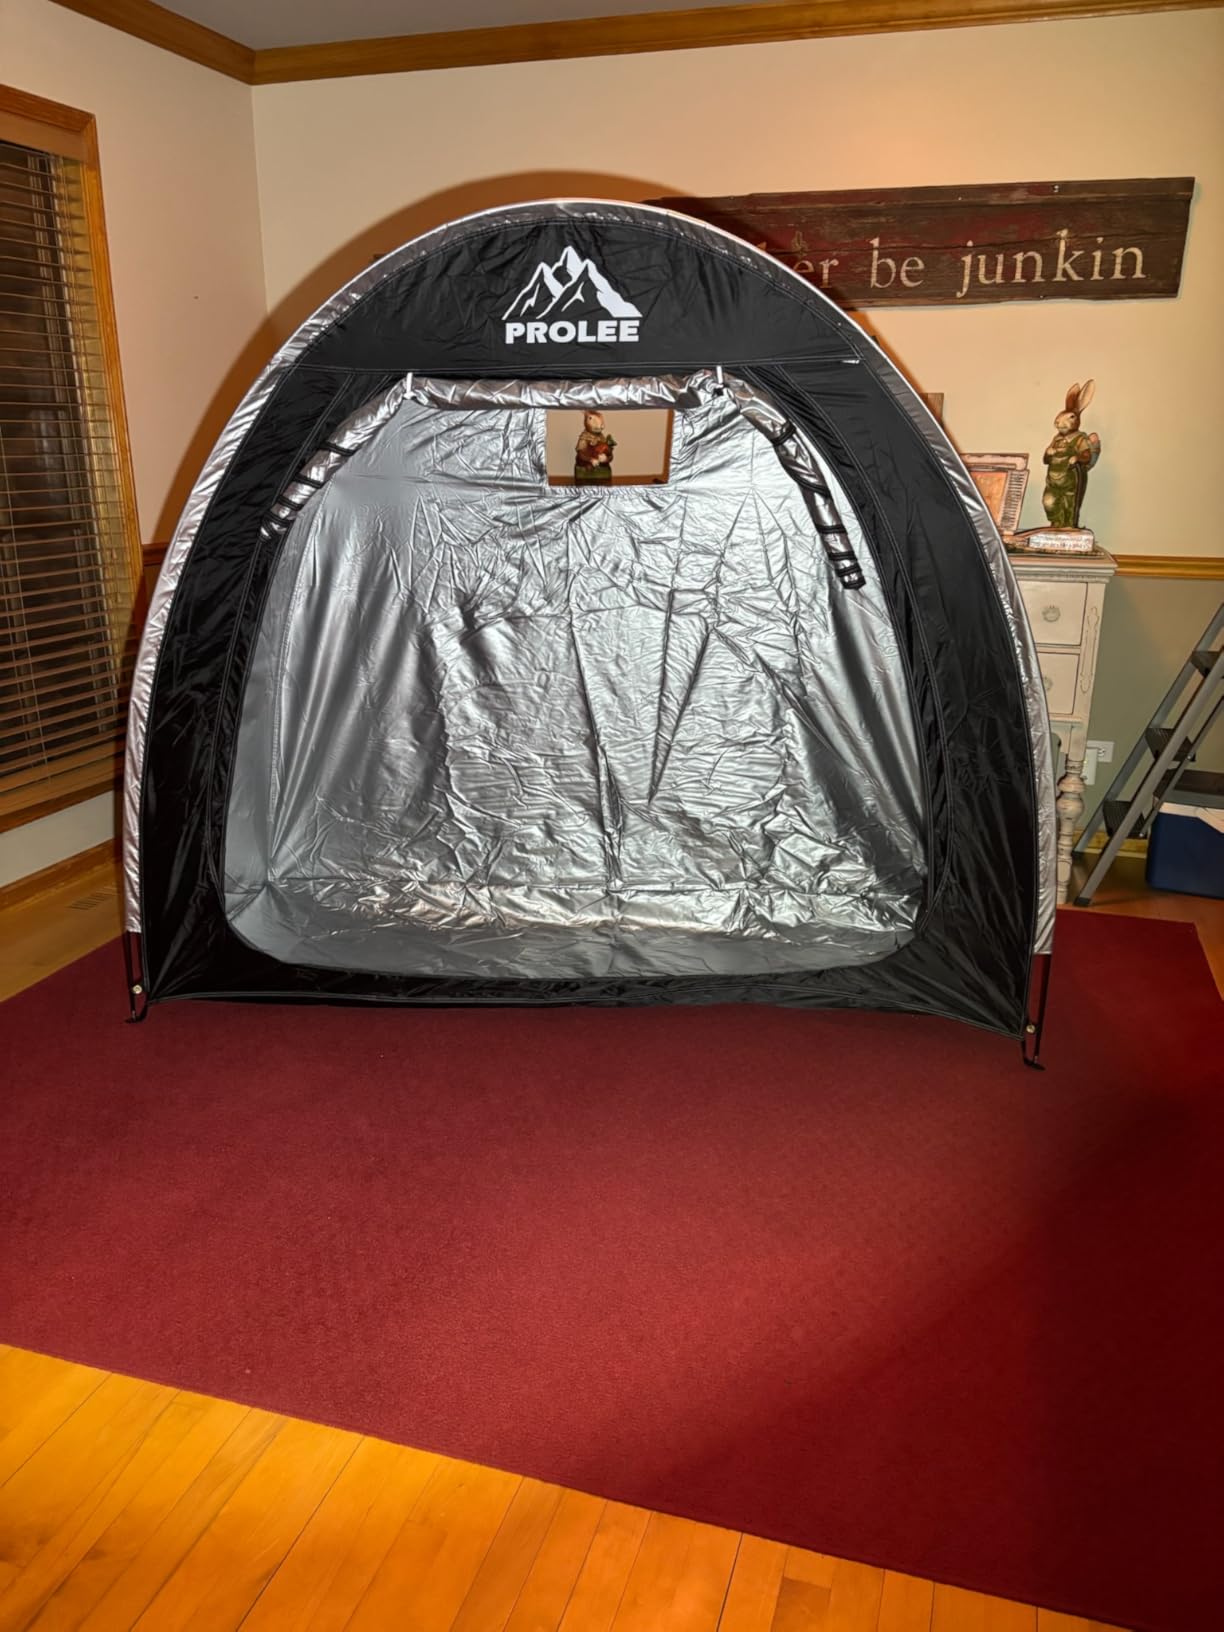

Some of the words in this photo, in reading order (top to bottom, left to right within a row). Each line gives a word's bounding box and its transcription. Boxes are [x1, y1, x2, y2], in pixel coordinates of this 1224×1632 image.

[870, 237, 925, 288] be
[956, 228, 1146, 298] junkin
[505, 320, 640, 344] PROLEE
